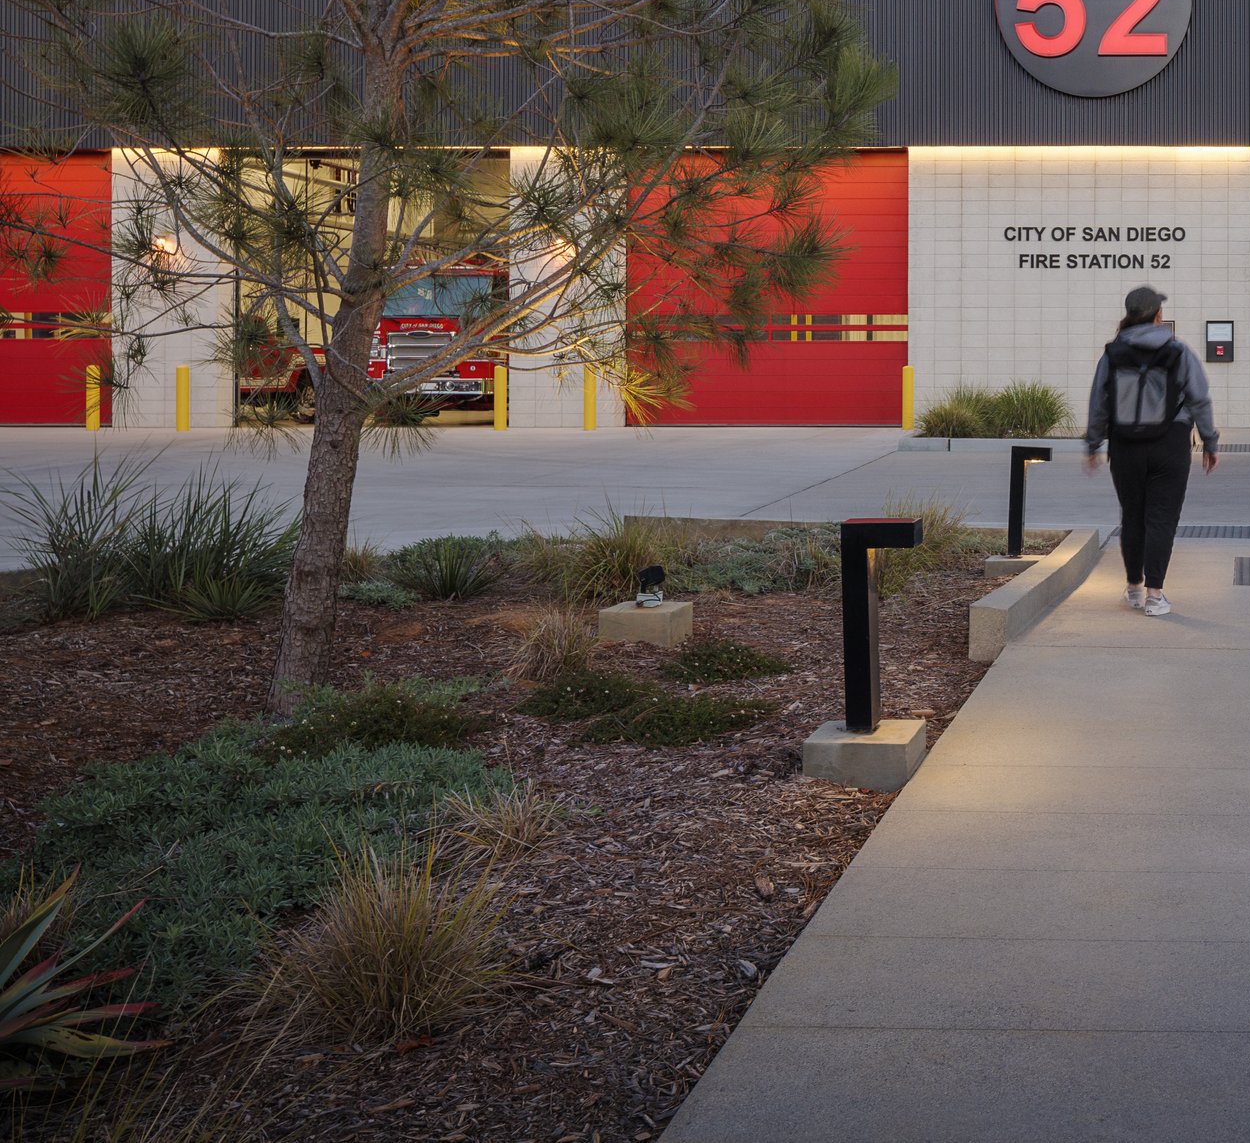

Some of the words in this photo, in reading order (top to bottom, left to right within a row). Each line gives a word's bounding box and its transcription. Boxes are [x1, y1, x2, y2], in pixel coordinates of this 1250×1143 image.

[1003, 226, 1046, 242] CITY
[1050, 226, 1077, 242] OF
[1081, 226, 1120, 242] SAN
[1126, 226, 1186, 242] DIEGO
[1018, 254, 1061, 269] FIRE
[1066, 254, 1144, 269] STATION
[1150, 254, 1171, 269] 52
